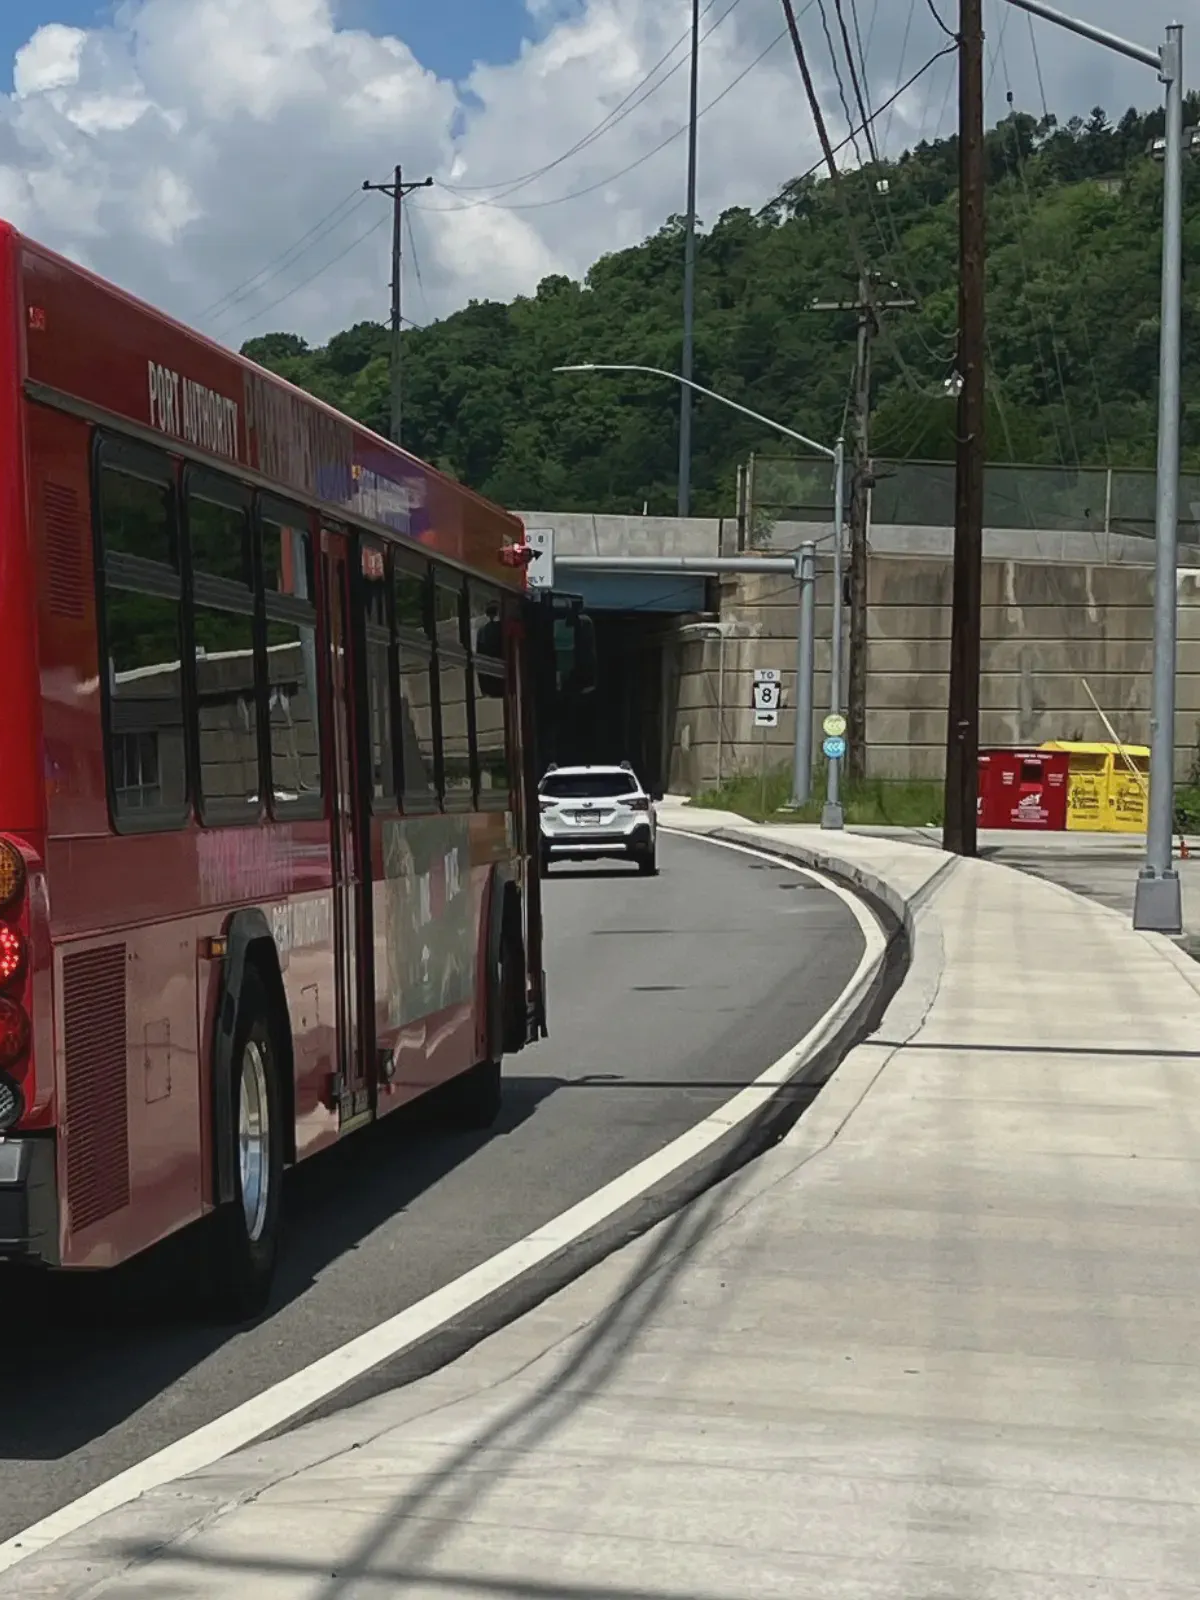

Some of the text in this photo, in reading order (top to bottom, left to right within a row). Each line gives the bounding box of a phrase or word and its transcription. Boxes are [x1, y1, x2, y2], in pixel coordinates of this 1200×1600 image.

[148, 360, 179, 436] PORT
[183, 376, 238, 459] AUTHORITY
[760, 671, 775, 679] TO
[761, 687, 772, 703] 8
